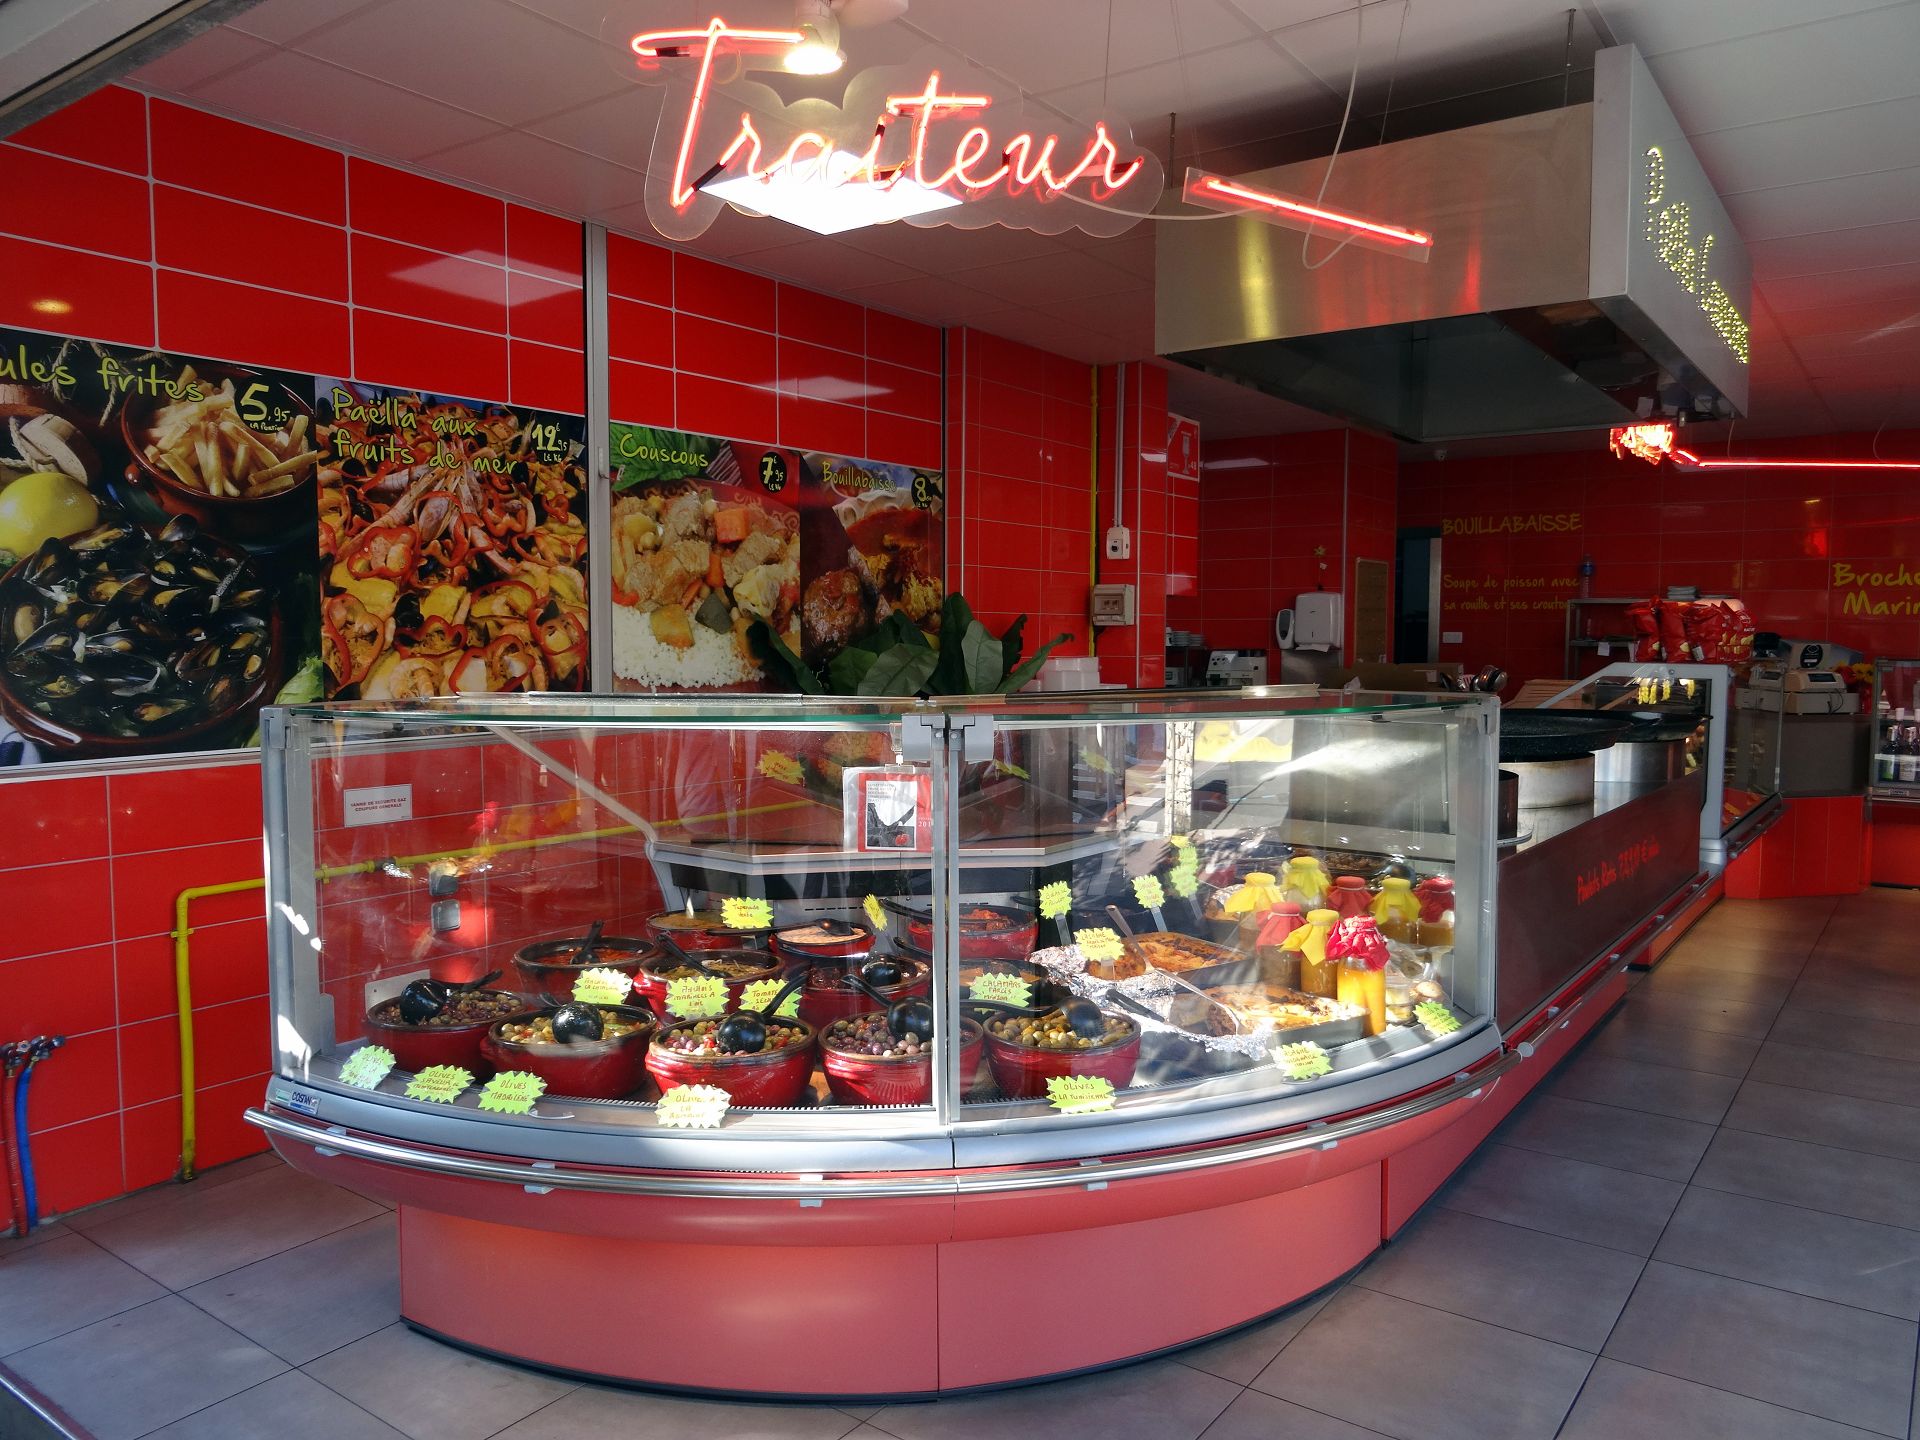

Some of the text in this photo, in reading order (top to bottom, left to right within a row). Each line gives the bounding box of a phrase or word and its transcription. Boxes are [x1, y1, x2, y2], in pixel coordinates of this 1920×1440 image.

[631, 18, 1144, 208] Traiteur
[96, 356, 205, 401] frites
[331, 387, 477, 436] Paëlla aux
[333, 428, 518, 475] fruits de mer
[620, 433, 709, 467] Couscous
[822, 461, 897, 493] Bouillabaisse
[1442, 513, 1582, 535] BOUILLABAISSE
[1443, 574, 1580, 593] Soupe de poisson avec
[1443, 601, 1456, 611] sa
[1494, 596, 1507, 610] et
[500, 1079, 528, 1090] OLIVES
[1063, 1082, 1096, 1091] OLIVES
